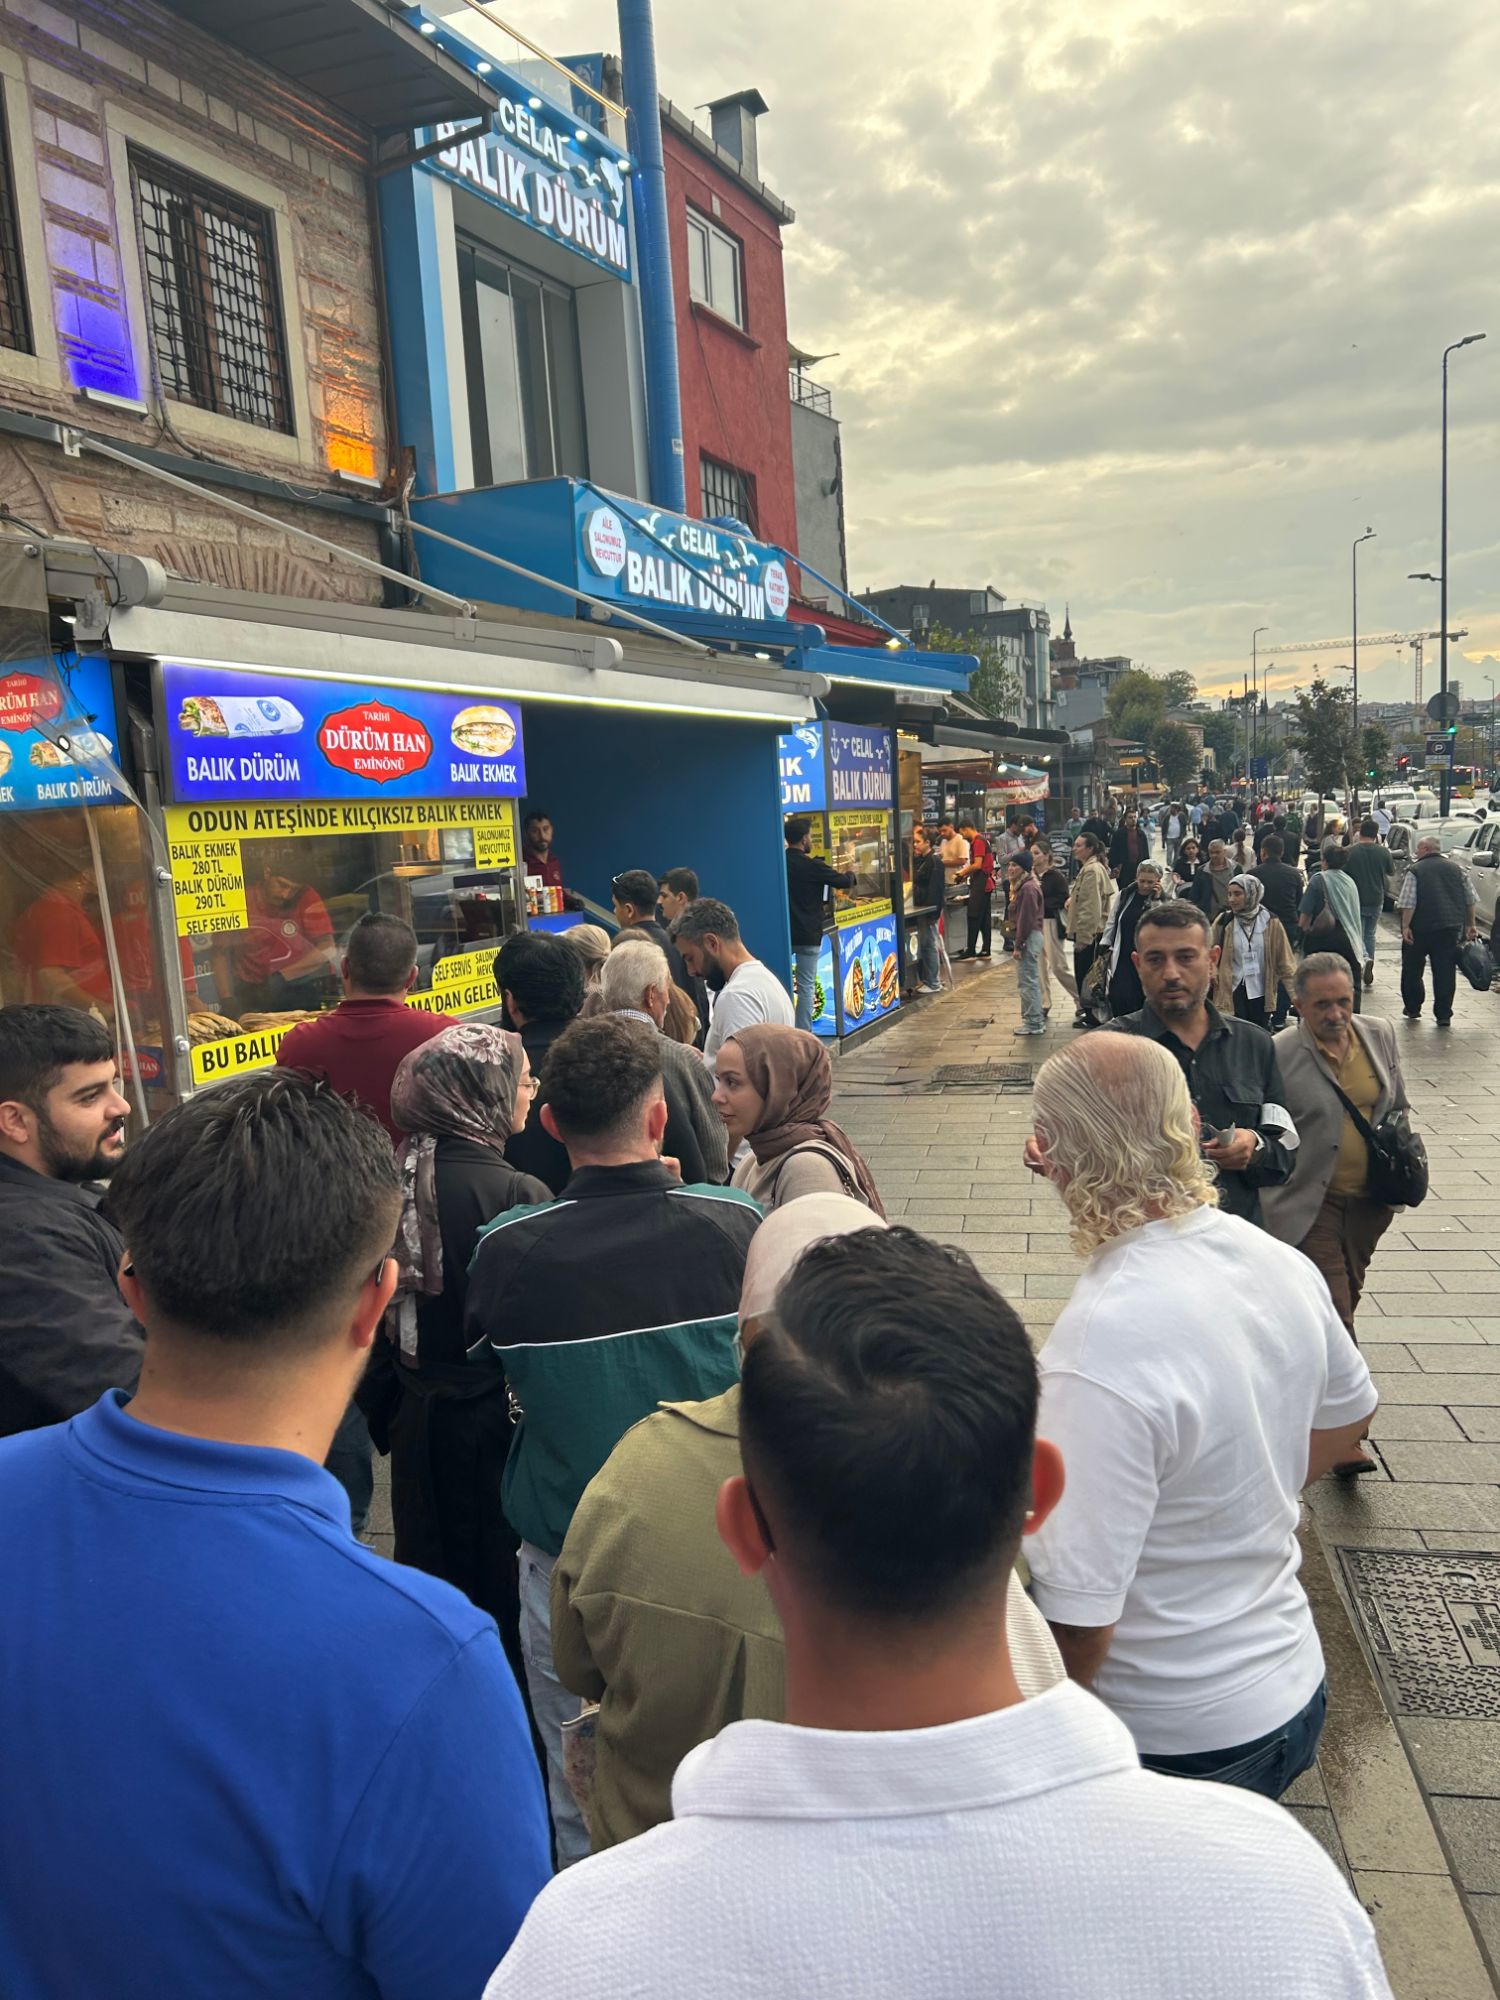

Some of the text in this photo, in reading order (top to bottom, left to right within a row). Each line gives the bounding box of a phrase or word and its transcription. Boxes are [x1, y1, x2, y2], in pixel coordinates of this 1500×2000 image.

[500, 97, 570, 170] CELAL
[436, 122, 627, 269] BALIK DÜRÜM
[679, 524, 720, 560] CELAL
[627, 550, 765, 620] BALIK DÜRÜM
[30, 690, 58, 708] HAN
[362, 710, 391, 722] TARİHİ
[325, 725, 426, 753] DÜRÜM HAN
[851, 736, 874, 758] CELAL
[187, 752, 300, 782] BALIK DÜRÜM
[353, 757, 405, 771] EMİNÖNÜ
[451, 763, 517, 784] BALIK EKMEK
[0, 786, 15, 802] EK
[37, 784, 69, 800] BALIK
[832, 766, 892, 801] BALIK DÜRÜM
[188, 803, 503, 833] ODUN ATEŞİNDE KILÇIKSIZ BALIK EKMEK
[477, 829, 510, 842] SALONUMUZ
[171, 842, 237, 860] BALIK EKMEK
[478, 842, 512, 855] MEVCUTTUR
[192, 859, 223, 875] 280 TL
[174, 873, 243, 895] BALIK DÜRÜM
[195, 894, 226, 910] 290 TL
[186, 913, 241, 935] SELF SERVİS
[435, 956, 472, 982] SELF SERVİS
[202, 1046, 230, 1073] BU
[464, 981, 501, 1005] GELEN
